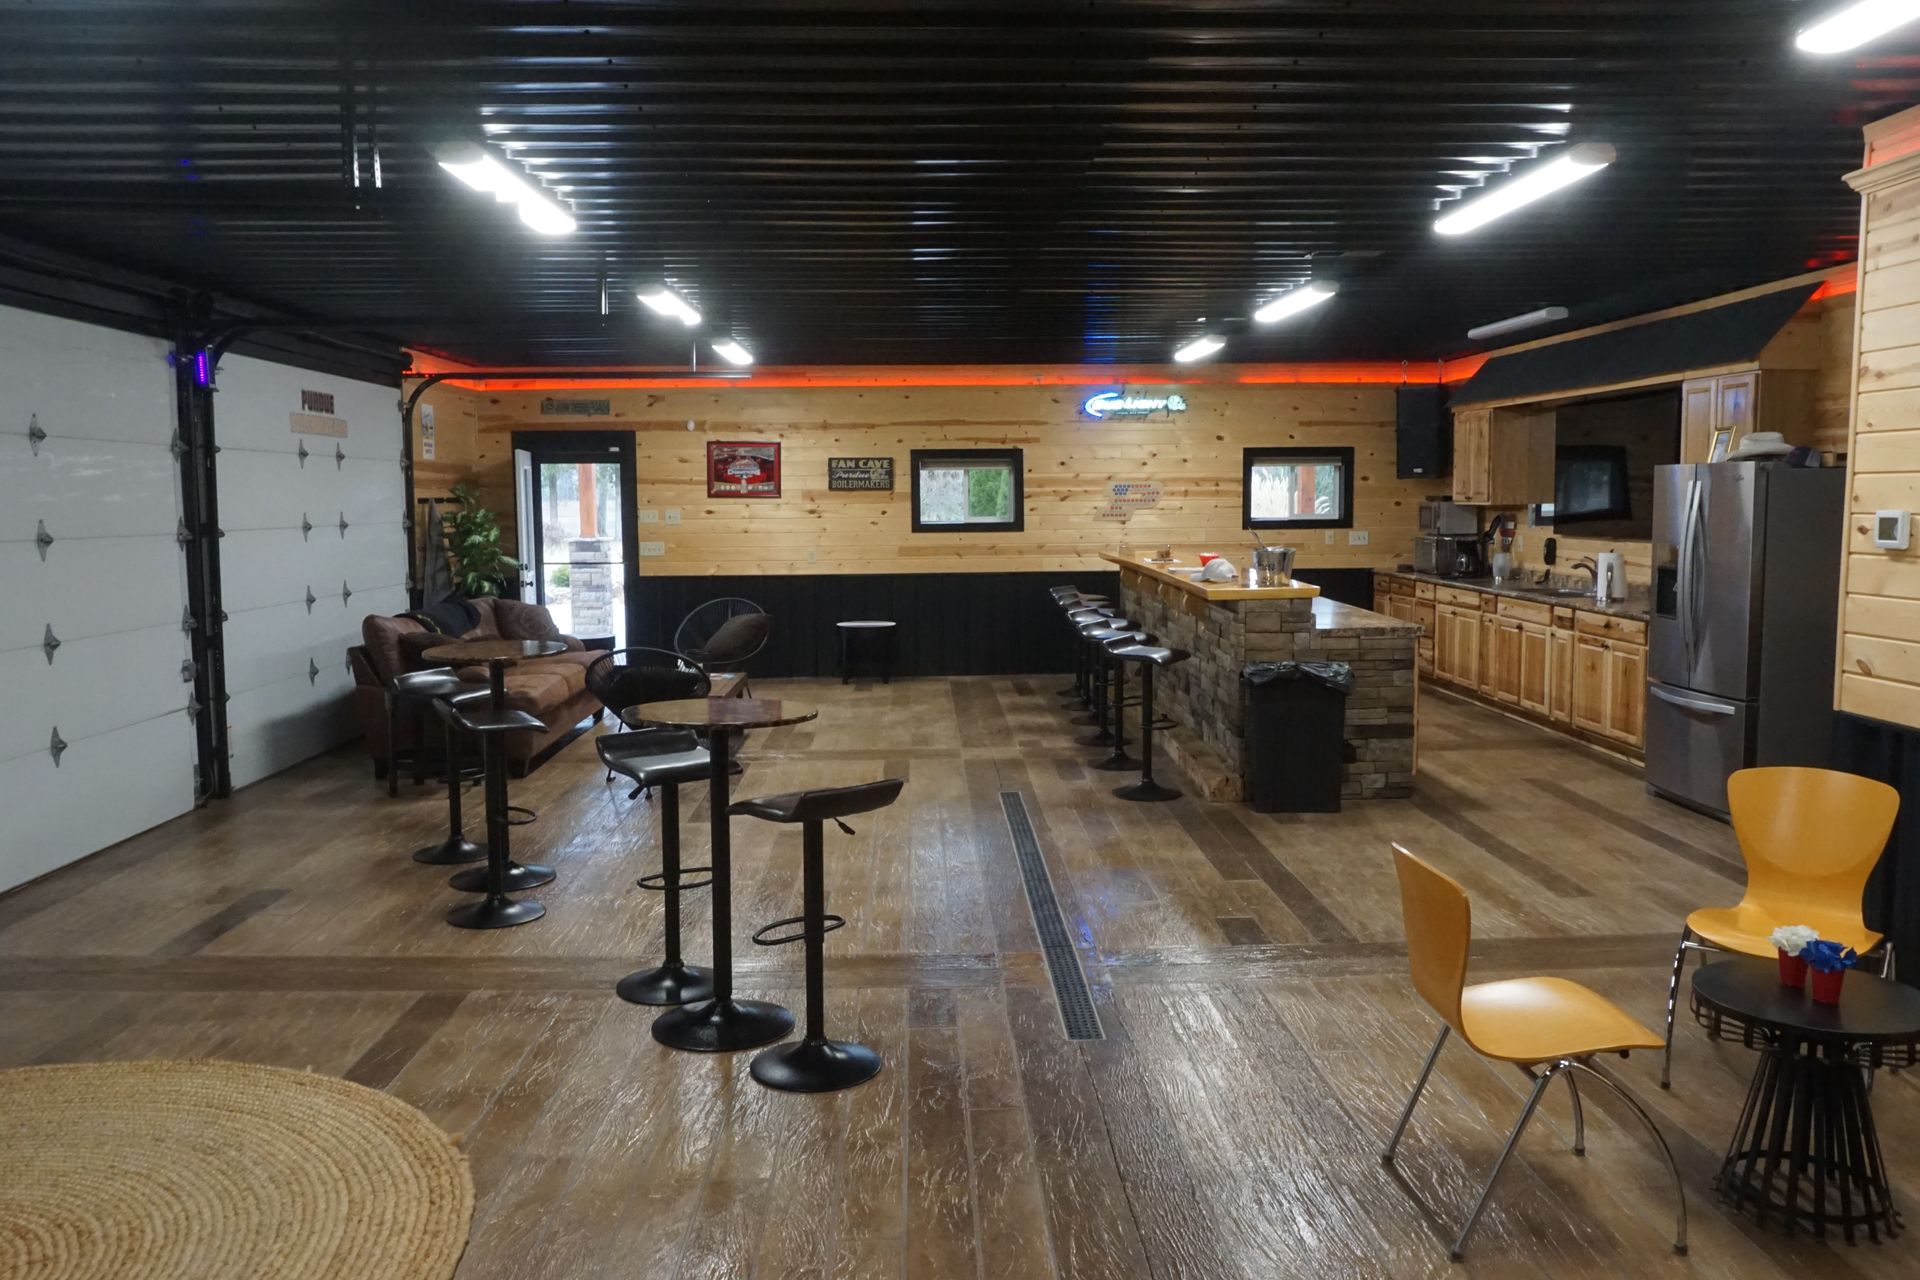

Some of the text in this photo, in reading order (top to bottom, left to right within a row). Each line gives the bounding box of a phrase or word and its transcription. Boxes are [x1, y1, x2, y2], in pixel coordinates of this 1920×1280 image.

[301, 389, 335, 415] PURDUE
[1124, 396, 1167, 409] LIGHT
[831, 459, 890, 468] FAN CAVE
[832, 471, 870, 479] Purdue
[832, 480, 890, 489] BOILERMAKERS
